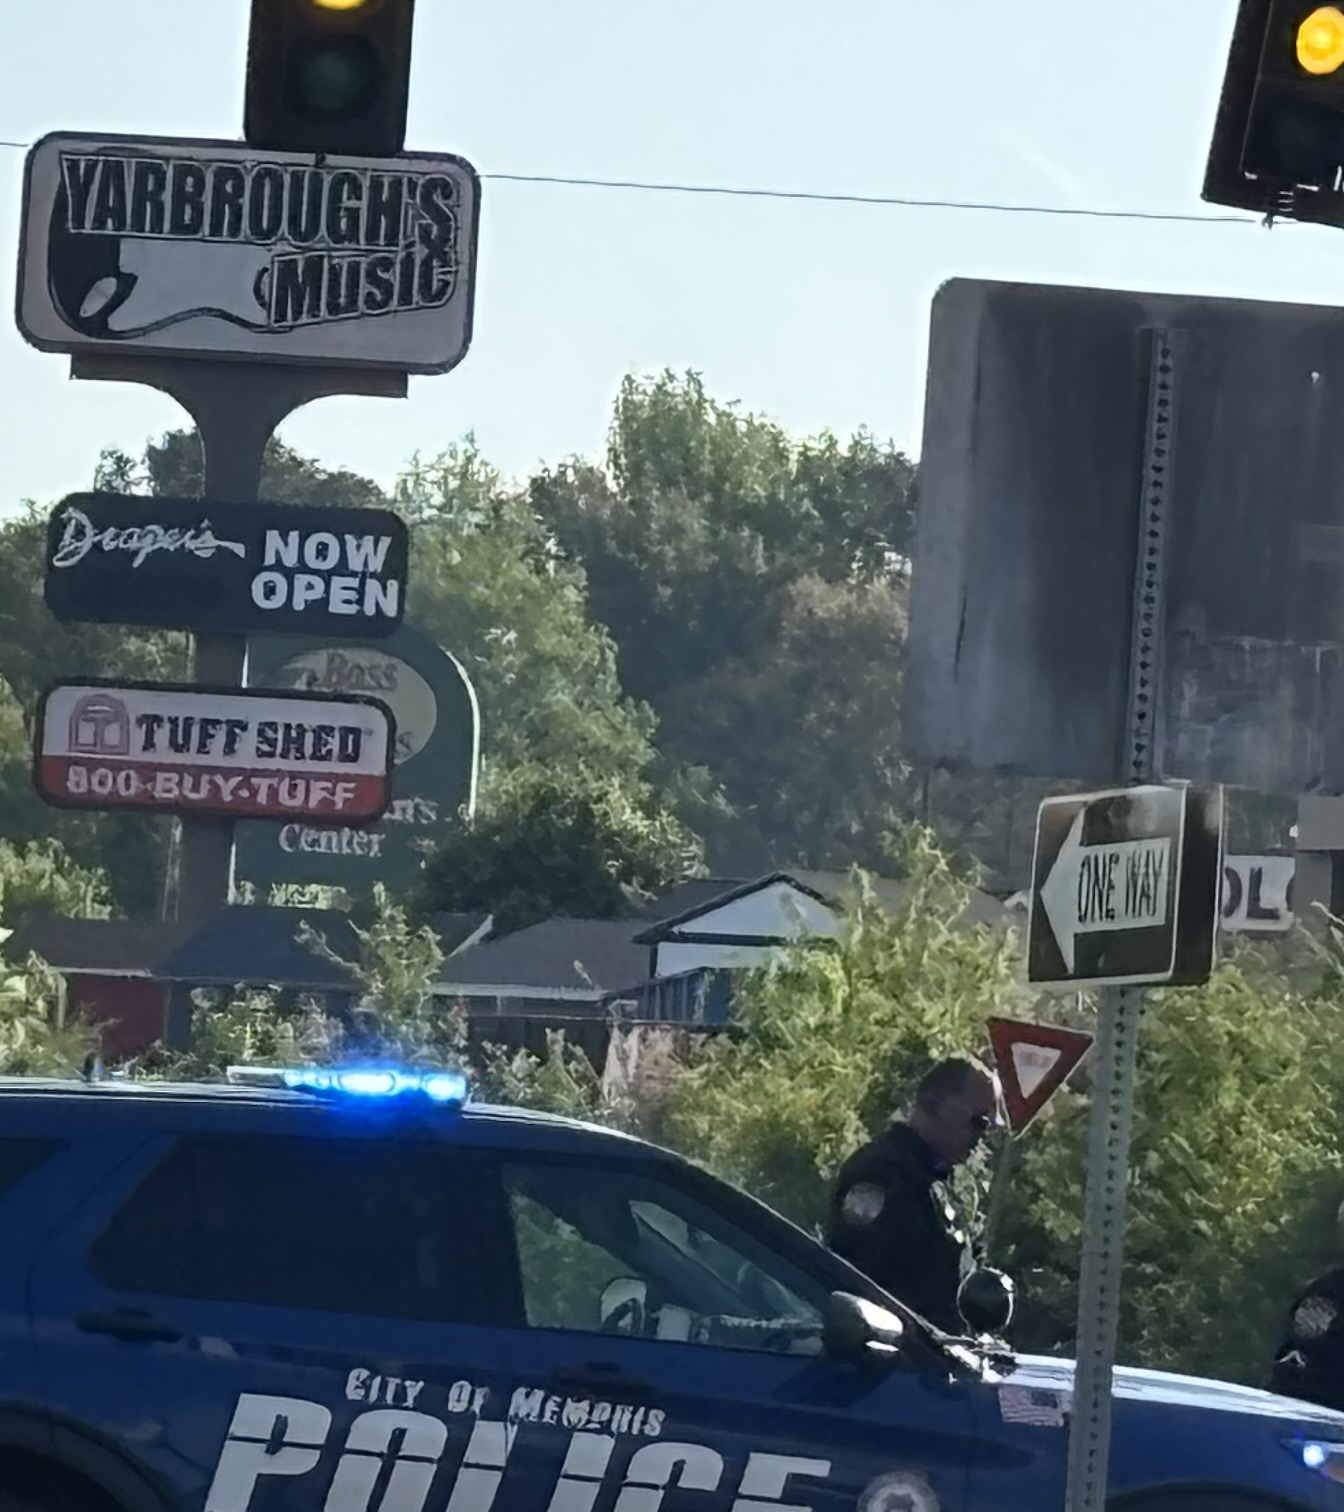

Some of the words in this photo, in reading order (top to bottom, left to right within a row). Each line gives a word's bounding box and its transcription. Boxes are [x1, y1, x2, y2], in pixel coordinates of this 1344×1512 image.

[61, 157, 458, 248] YARBROUGH'S
[271, 250, 457, 327] MUSIC
[263, 528, 393, 573] NOW
[250, 572, 399, 618] OPEN
[136, 713, 249, 757] TUFF
[255, 720, 364, 764] SHED
[278, 823, 386, 858] Center
[1077, 853, 1122, 922] ONE
[1127, 847, 1166, 918] WAY
[346, 1367, 424, 1409] CITY
[448, 1380, 490, 1416] OF
[510, 1386, 668, 1438] MEMPHIS
